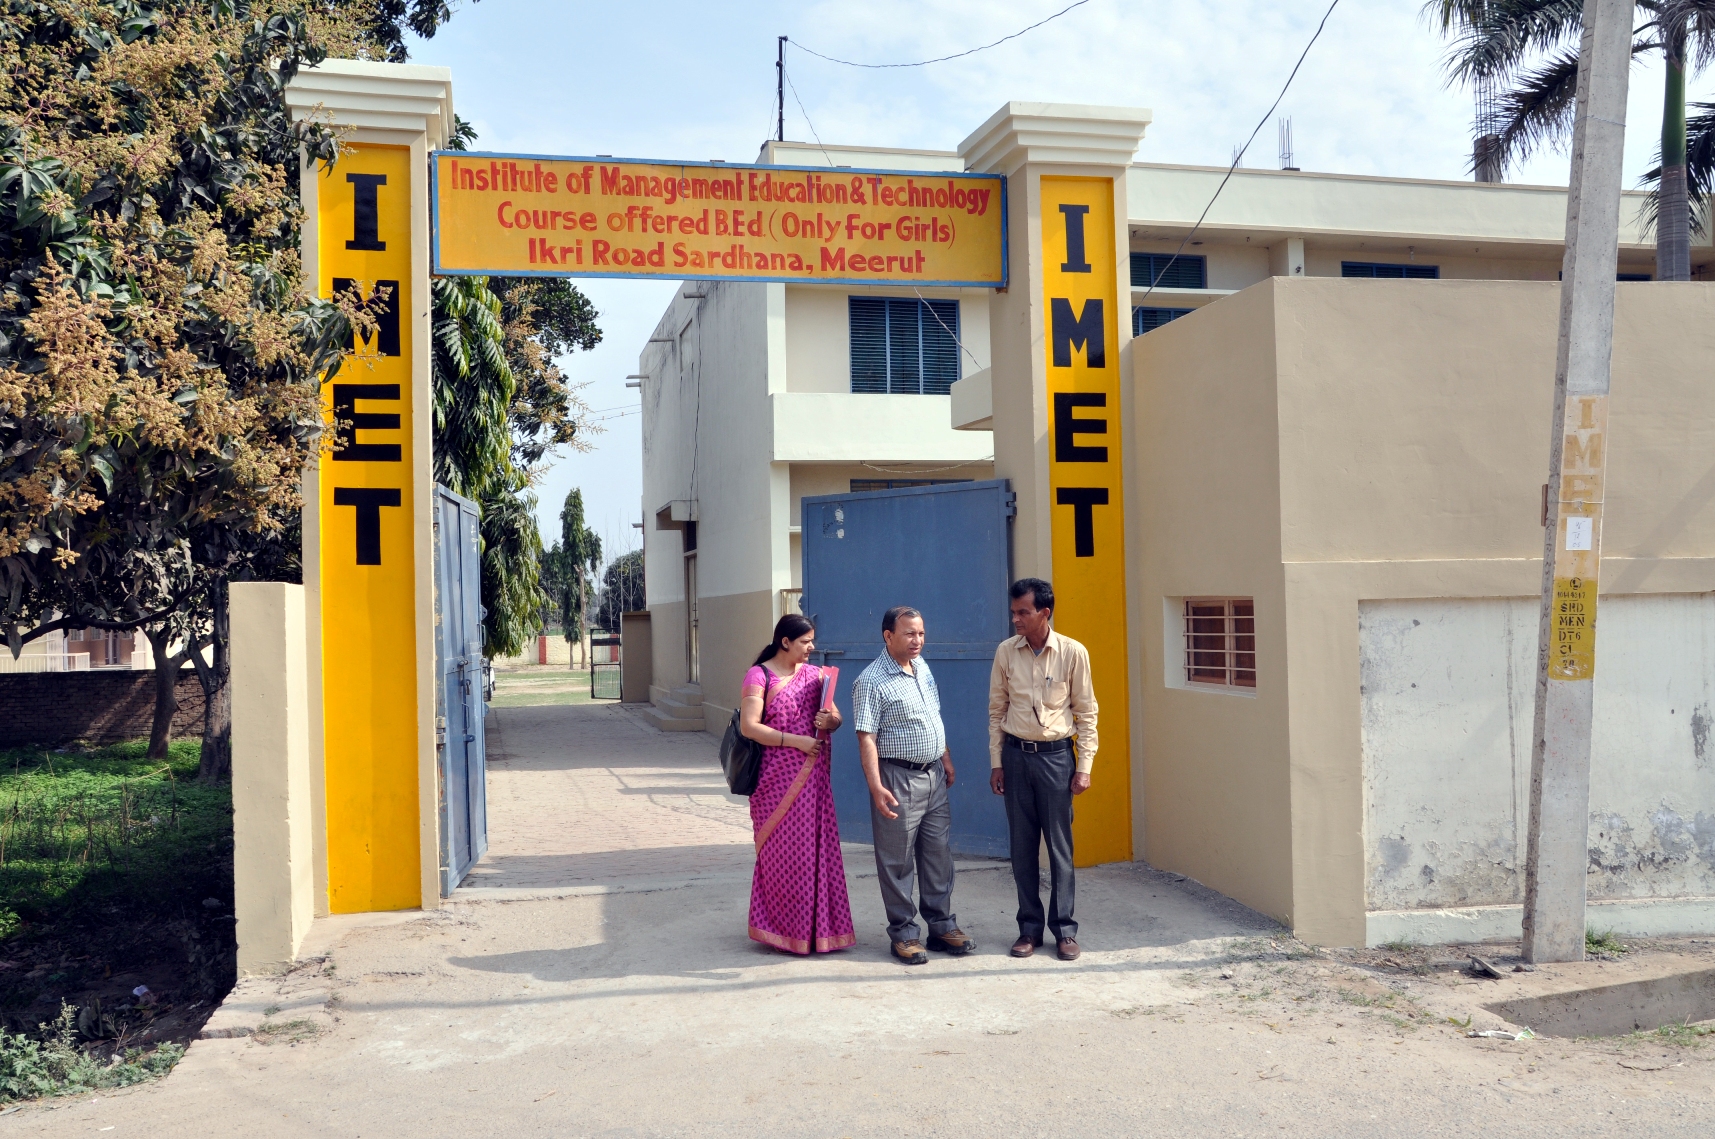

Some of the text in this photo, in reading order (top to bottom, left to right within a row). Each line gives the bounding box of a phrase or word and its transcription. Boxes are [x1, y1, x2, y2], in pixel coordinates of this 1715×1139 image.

[451, 159, 558, 194] Institute
[565, 165, 594, 195] of
[600, 166, 744, 205] Management
[497, 200, 598, 232] Course
[606, 204, 709, 236] offered
[528, 237, 926, 275] Ikri Road Sardhana, Meerut
[332, 173, 402, 565] IMET
[1051, 204, 1109, 557] IMET
